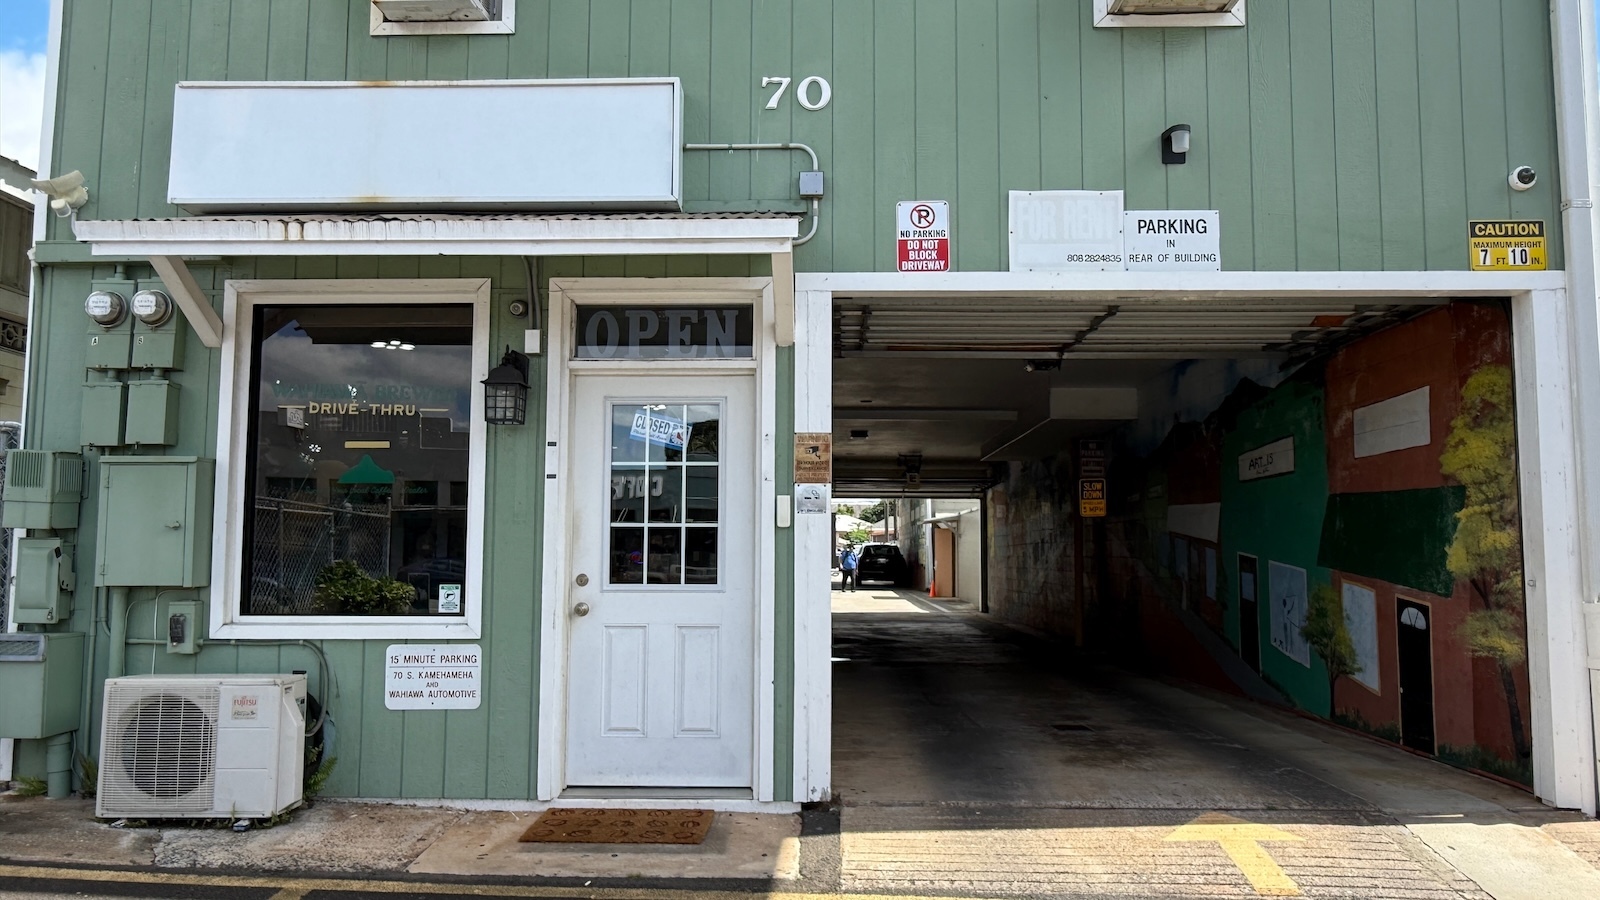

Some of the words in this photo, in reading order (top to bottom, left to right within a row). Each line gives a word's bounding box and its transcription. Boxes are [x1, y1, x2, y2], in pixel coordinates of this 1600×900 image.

[761, 76, 832, 111] 70
[1016, 200, 1057, 240] FOR
[1063, 199, 1116, 240] RENT
[1138, 218, 1207, 234] PARKING
[1474, 223, 1540, 236] CAUTION
[900, 230, 911, 238] NO
[912, 229, 946, 238] PARKING
[907, 240, 920, 250] DO
[921, 240, 939, 250] NOT
[1166, 239, 1176, 248] IN
[1473, 241, 1513, 249] MAXIMUM
[1514, 241, 1542, 249] HEIGHT
[908, 250, 938, 260] BLOCK
[1129, 254, 1153, 263] REAR
[1157, 254, 1170, 263] OF
[1175, 254, 1217, 263] BUILDING
[1480, 249, 1489, 265] 7
[1496, 257, 1508, 265] FT.
[1511, 249, 1528, 265] 10
[1531, 257, 1543, 265] IN.
[901, 260, 946, 271] DRIVEWAY
[585, 309, 740, 359] OPEN
[308, 401, 417, 416] DRIVE-THRU
[635, 415, 671, 435] CLOSED
[1083, 482, 1103, 491] SLOW
[1083, 491, 1103, 499] DOWN
[390, 655, 399, 664] 15
[403, 654, 436, 664] MINUTE
[440, 654, 477, 664] PARKING
[393, 671, 403, 680] 70
[407, 671, 415, 680] S.
[418, 670, 473, 679] KAMEHAMEHA
[389, 690, 424, 698] WAHIAWA
[428, 689, 477, 698] AUTOMOTIVE
[233, 698, 257, 707] FUJITSU
